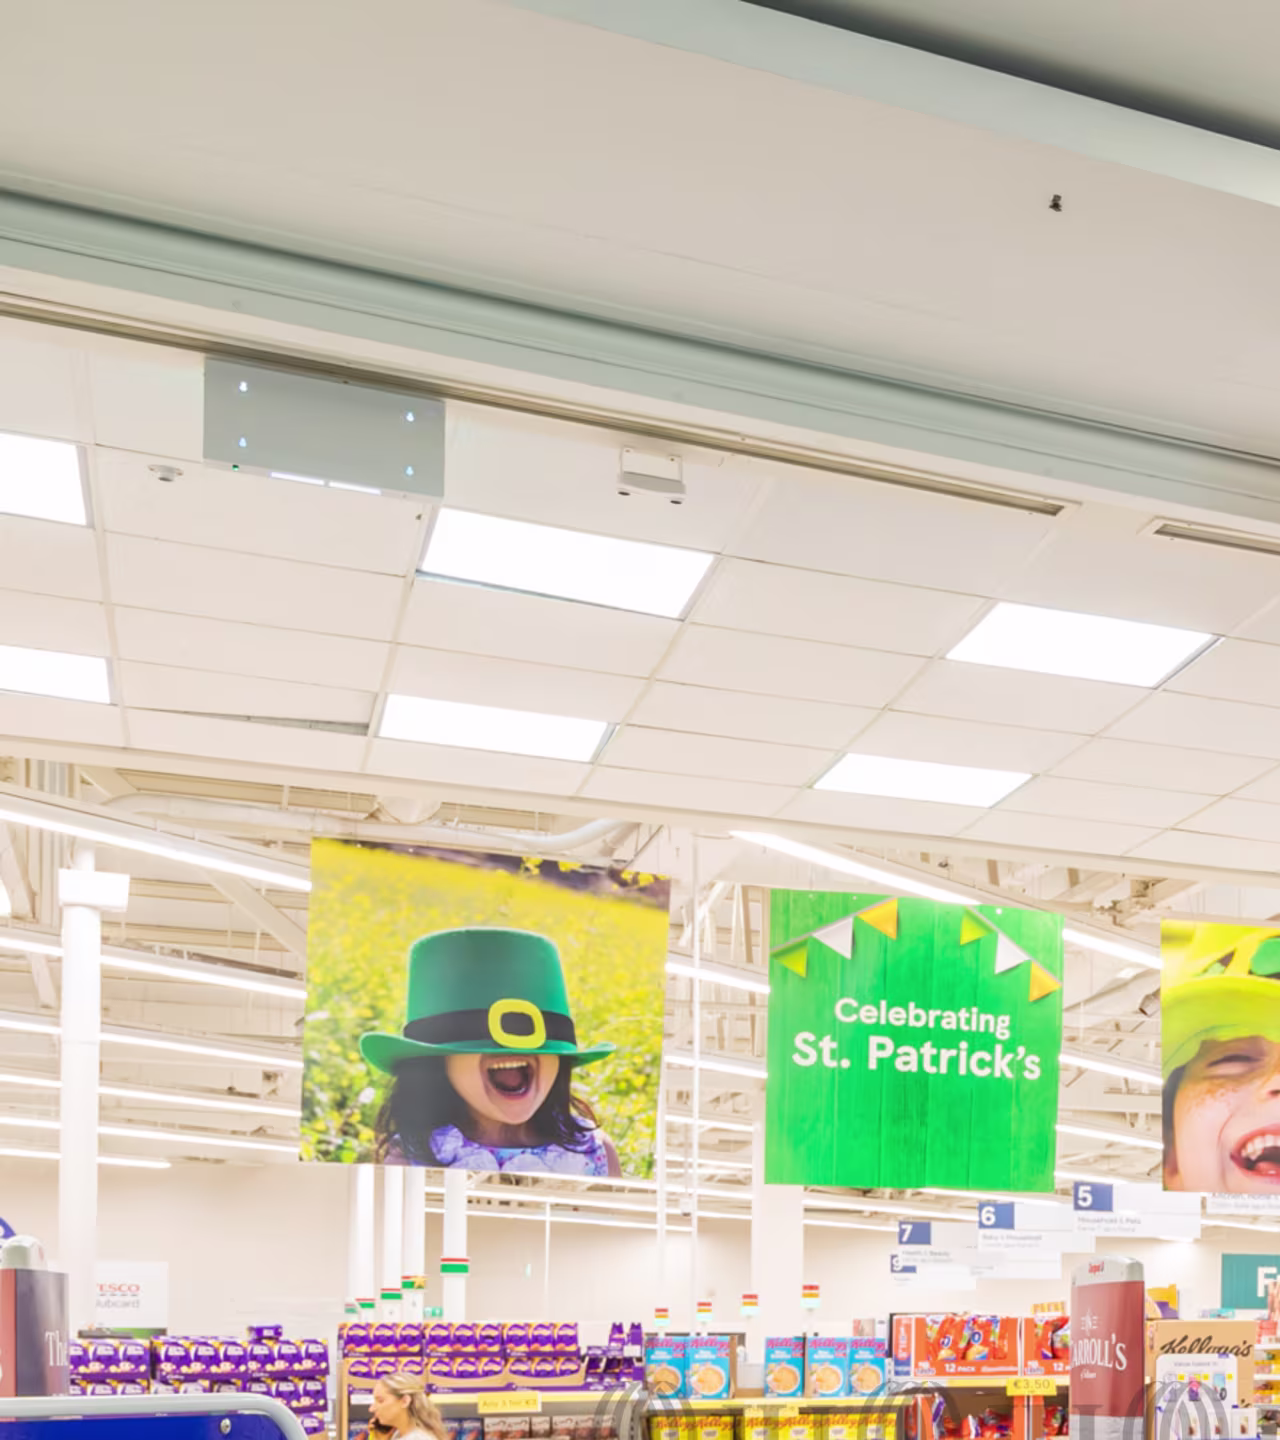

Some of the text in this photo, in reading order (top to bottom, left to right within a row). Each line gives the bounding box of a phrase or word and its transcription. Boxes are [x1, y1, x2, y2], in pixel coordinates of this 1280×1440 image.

[834, 997, 1010, 1040] Celebrating
[792, 1032, 1041, 1081] St. Patrick's
[1077, 1186, 1093, 1207] 5
[980, 1206, 996, 1226] 6
[900, 1224, 913, 1242] 7
[1013, 1378, 1050, 1390] €3.50
